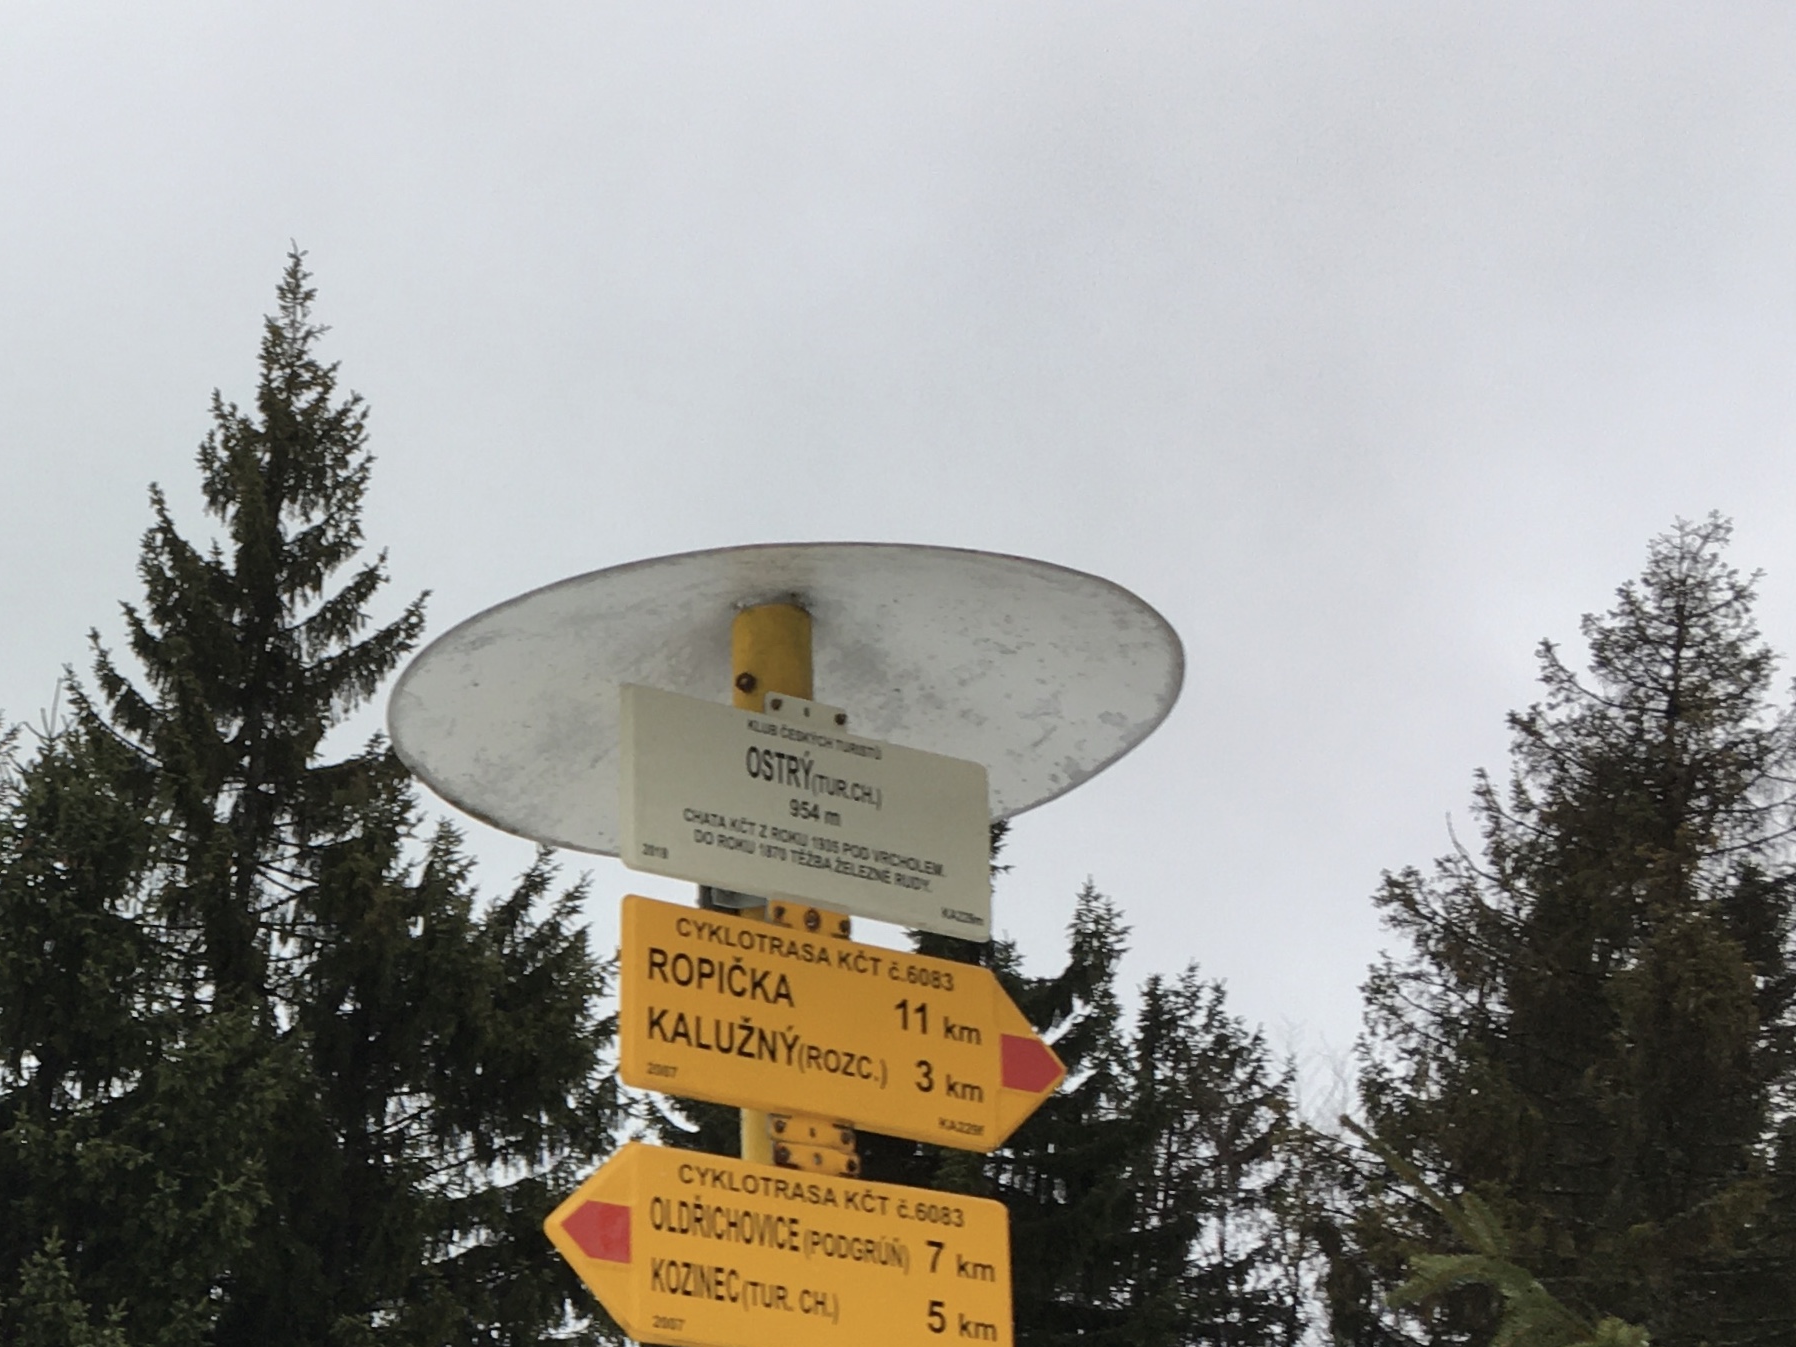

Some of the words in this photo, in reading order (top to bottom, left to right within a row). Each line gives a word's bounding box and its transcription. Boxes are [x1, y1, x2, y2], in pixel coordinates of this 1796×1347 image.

[747, 719, 778, 736] KLUB
[682, 807, 726, 829] CHATA
[729, 814, 757, 837] KČT
[770, 827, 808, 848] ROKU
[841, 842, 870, 860] POD
[788, 798, 820, 821] 954
[824, 810, 841, 827] m
[693, 828, 715, 846] DO
[716, 834, 756, 855] ROKU
[790, 847, 832, 871] TĚŽBA
[833, 856, 892, 885] ŽELEZNÉ
[648, 946, 796, 1009] ROPIČKA
[676, 917, 832, 967] CYKLOTRASA
[837, 951, 882, 977] KČT
[887, 961, 955, 992] č.6083
[894, 998, 928, 1035] 11
[943, 1015, 982, 1046] km
[914, 1059, 935, 1094] 3
[945, 1074, 984, 1104] km
[678, 1163, 839, 1208] CYKLOTRASA
[843, 1188, 891, 1217] KČT
[895, 1197, 965, 1229] č.6083
[650, 1196, 801, 1253] OLDŘICHOVICE
[926, 1240, 946, 1274] 7
[956, 1253, 996, 1283] km
[927, 1300, 947, 1335] 5
[958, 1312, 998, 1342] km
